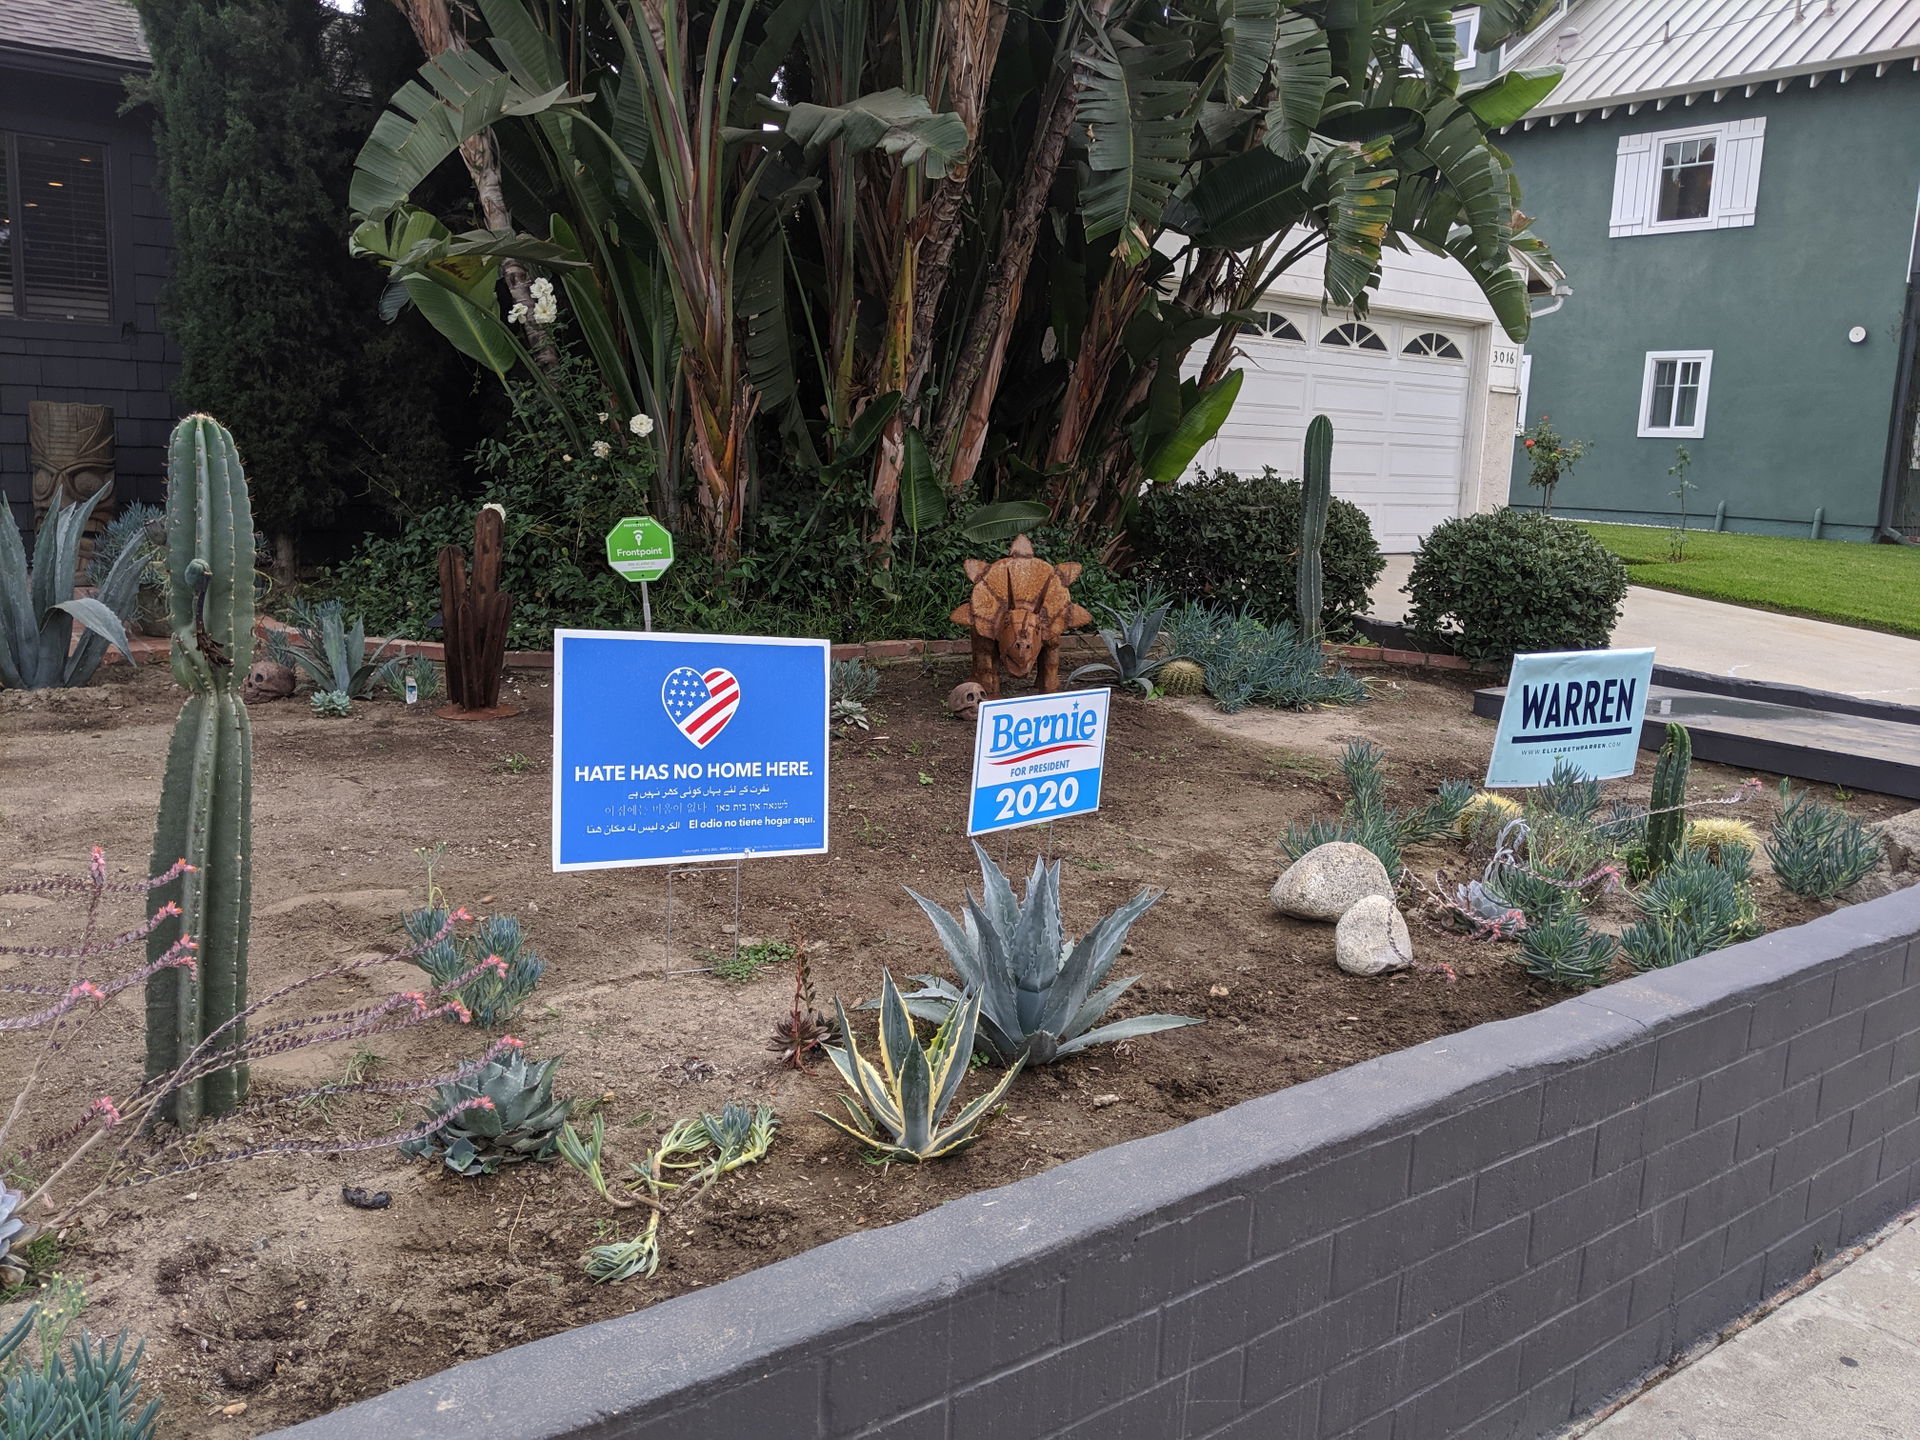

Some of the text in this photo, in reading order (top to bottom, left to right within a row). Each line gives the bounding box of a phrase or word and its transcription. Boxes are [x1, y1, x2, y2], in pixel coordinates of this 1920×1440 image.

[1493, 351, 1514, 364] 3016
[617, 547, 662, 557] Frontpoint
[1522, 678, 1636, 729] WARREN
[990, 701, 1097, 753] Bernie
[574, 761, 813, 782] HATE HAS NO HOME HERE.
[1010, 760, 1070, 777] FOR PRESIDENT
[994, 777, 1079, 821] 2020
[689, 819, 698, 829] El
[700, 818, 722, 828] odio
[725, 819, 737, 828] no
[739, 817, 763, 827] tiene
[765, 815, 791, 827] hogar
